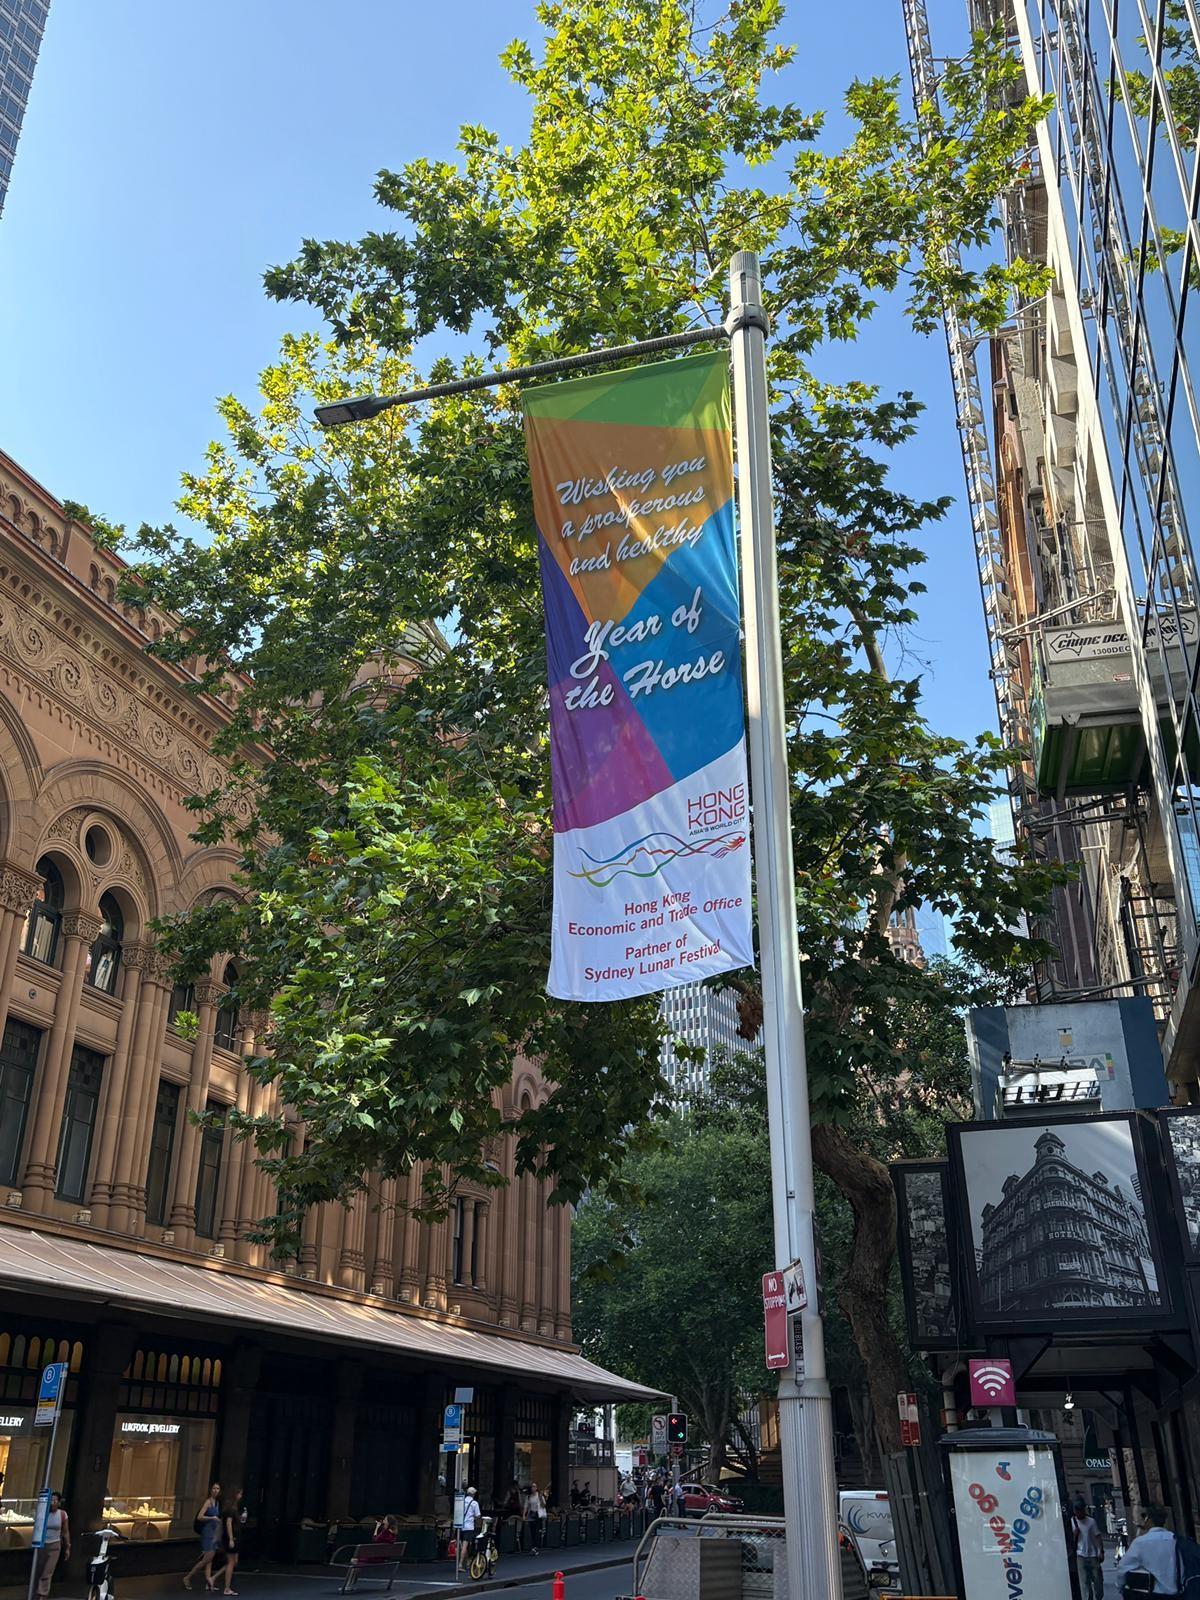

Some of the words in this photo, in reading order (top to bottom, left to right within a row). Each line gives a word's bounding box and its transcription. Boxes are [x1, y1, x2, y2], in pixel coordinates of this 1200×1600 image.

[556, 466, 656, 504] Wishing
[662, 456, 706, 486] you
[561, 520, 575, 539] a
[578, 486, 706, 542] prosperous
[569, 542, 612, 576] and
[616, 517, 704, 562] healthy
[570, 615, 662, 679] Year
[672, 586, 702, 634] of
[1102, 633, 1128, 643] DEC
[1092, 645, 1131, 655] 1300DEC
[565, 676, 614, 710] the
[623, 651, 725, 698] Horse
[688, 783, 745, 813] HONG
[688, 799, 745, 829] KONG
[710, 821, 732, 831] WORLD
[733, 816, 745, 825] CITY
[568, 920, 636, 936] Economic
[641, 914, 664, 929] and
[669, 904, 698, 922] Trade
[703, 896, 742, 913] Office
[625, 900, 658, 916] Hong
[662, 891, 691, 907] Kong
[584, 966, 635, 983] Sydney
[639, 957, 675, 975] Lunar
[680, 939, 721, 965] Festival
[625, 941, 672, 960] Partner
[675, 934, 688, 949] of
[768, 1278, 777, 1292] NO
[1086, 1459, 1111, 1467] OPALS
[1003, 1558, 1023, 1600] ver
